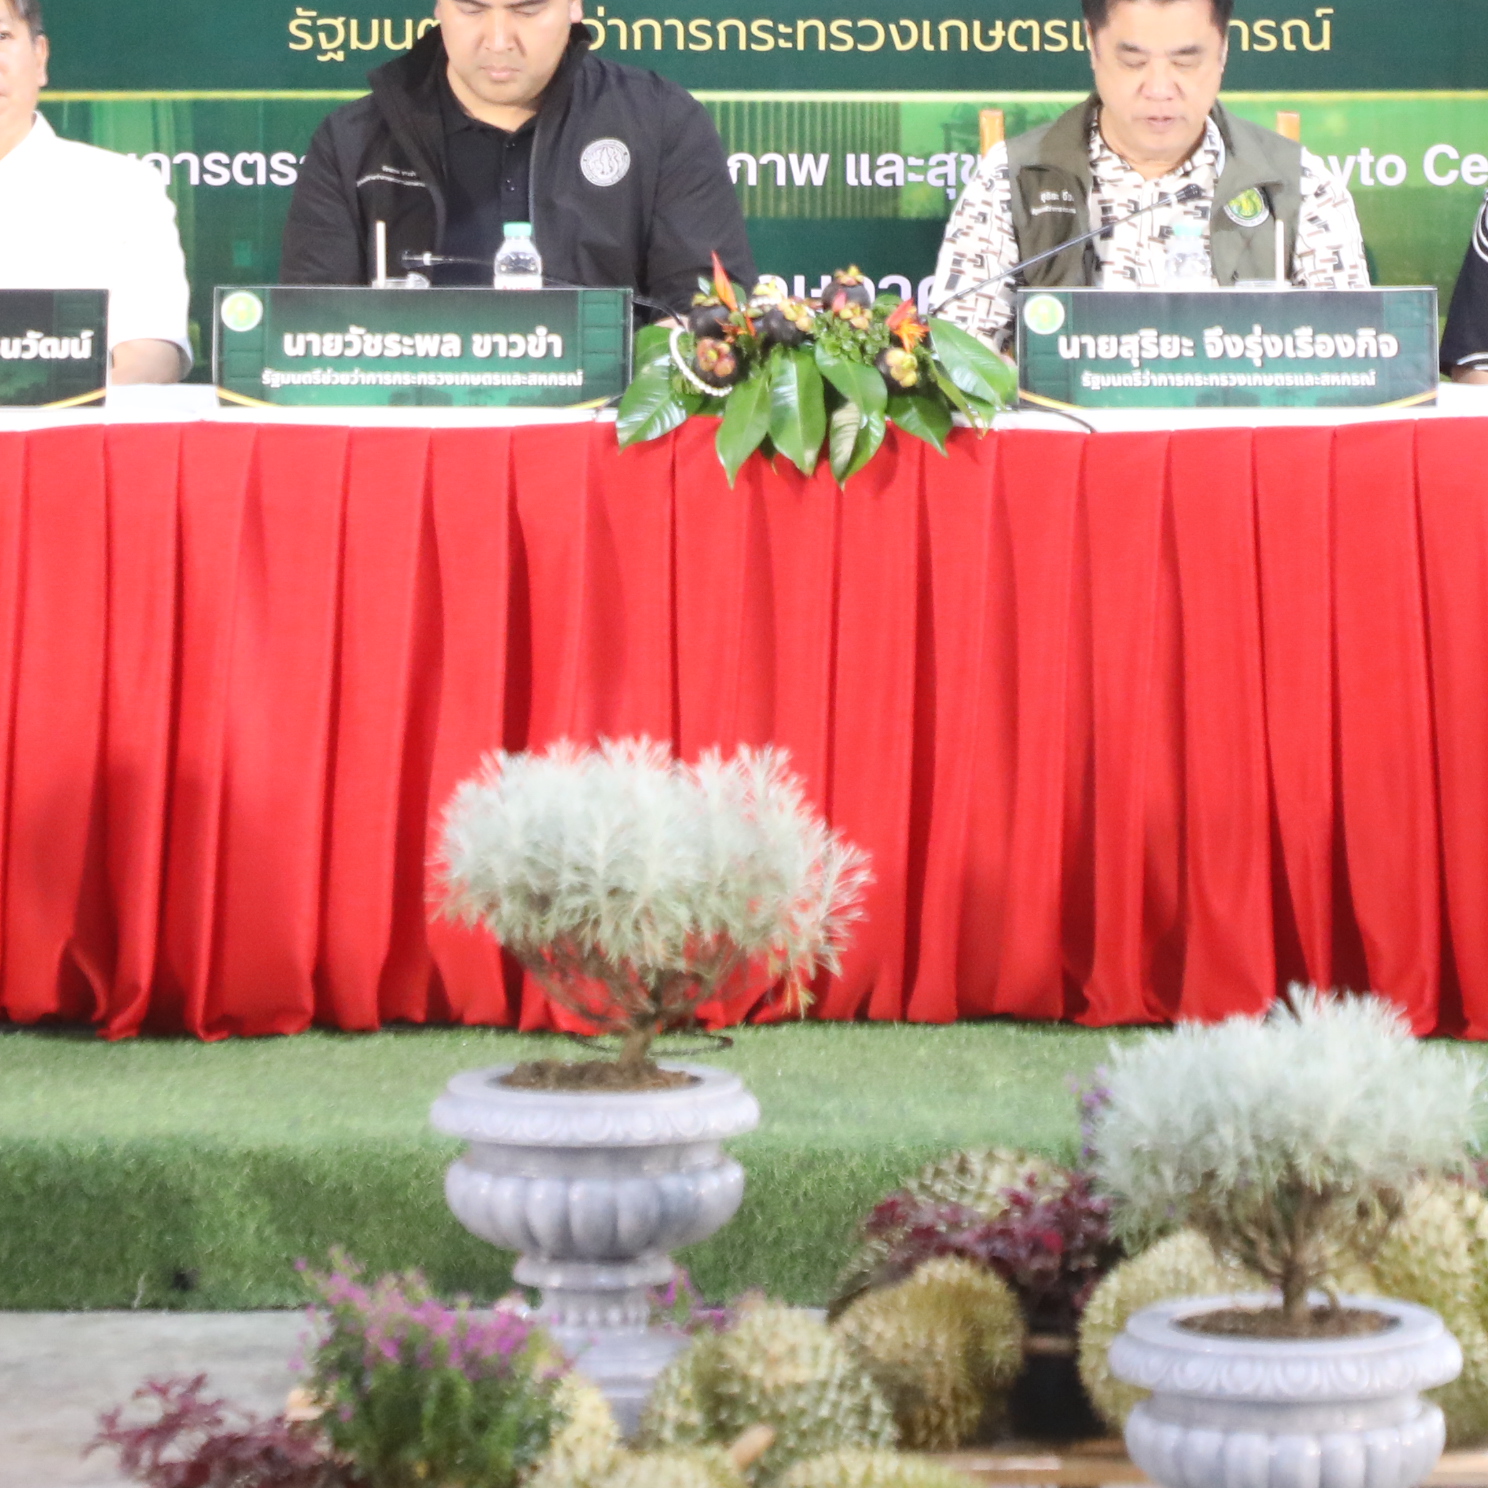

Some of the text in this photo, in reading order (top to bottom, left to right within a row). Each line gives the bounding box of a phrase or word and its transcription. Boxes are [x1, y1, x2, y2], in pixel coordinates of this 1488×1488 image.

[282, 324, 564, 359] นายวัชระพล ขาวขำ
[1057, 323, 1400, 368] นายสุริยะ จึงรุ่งเรืองกิจ
[1080, 368, 1379, 391] รัฐมนตรีว่าการกระทรวงเกษตรและสหกรณ์
